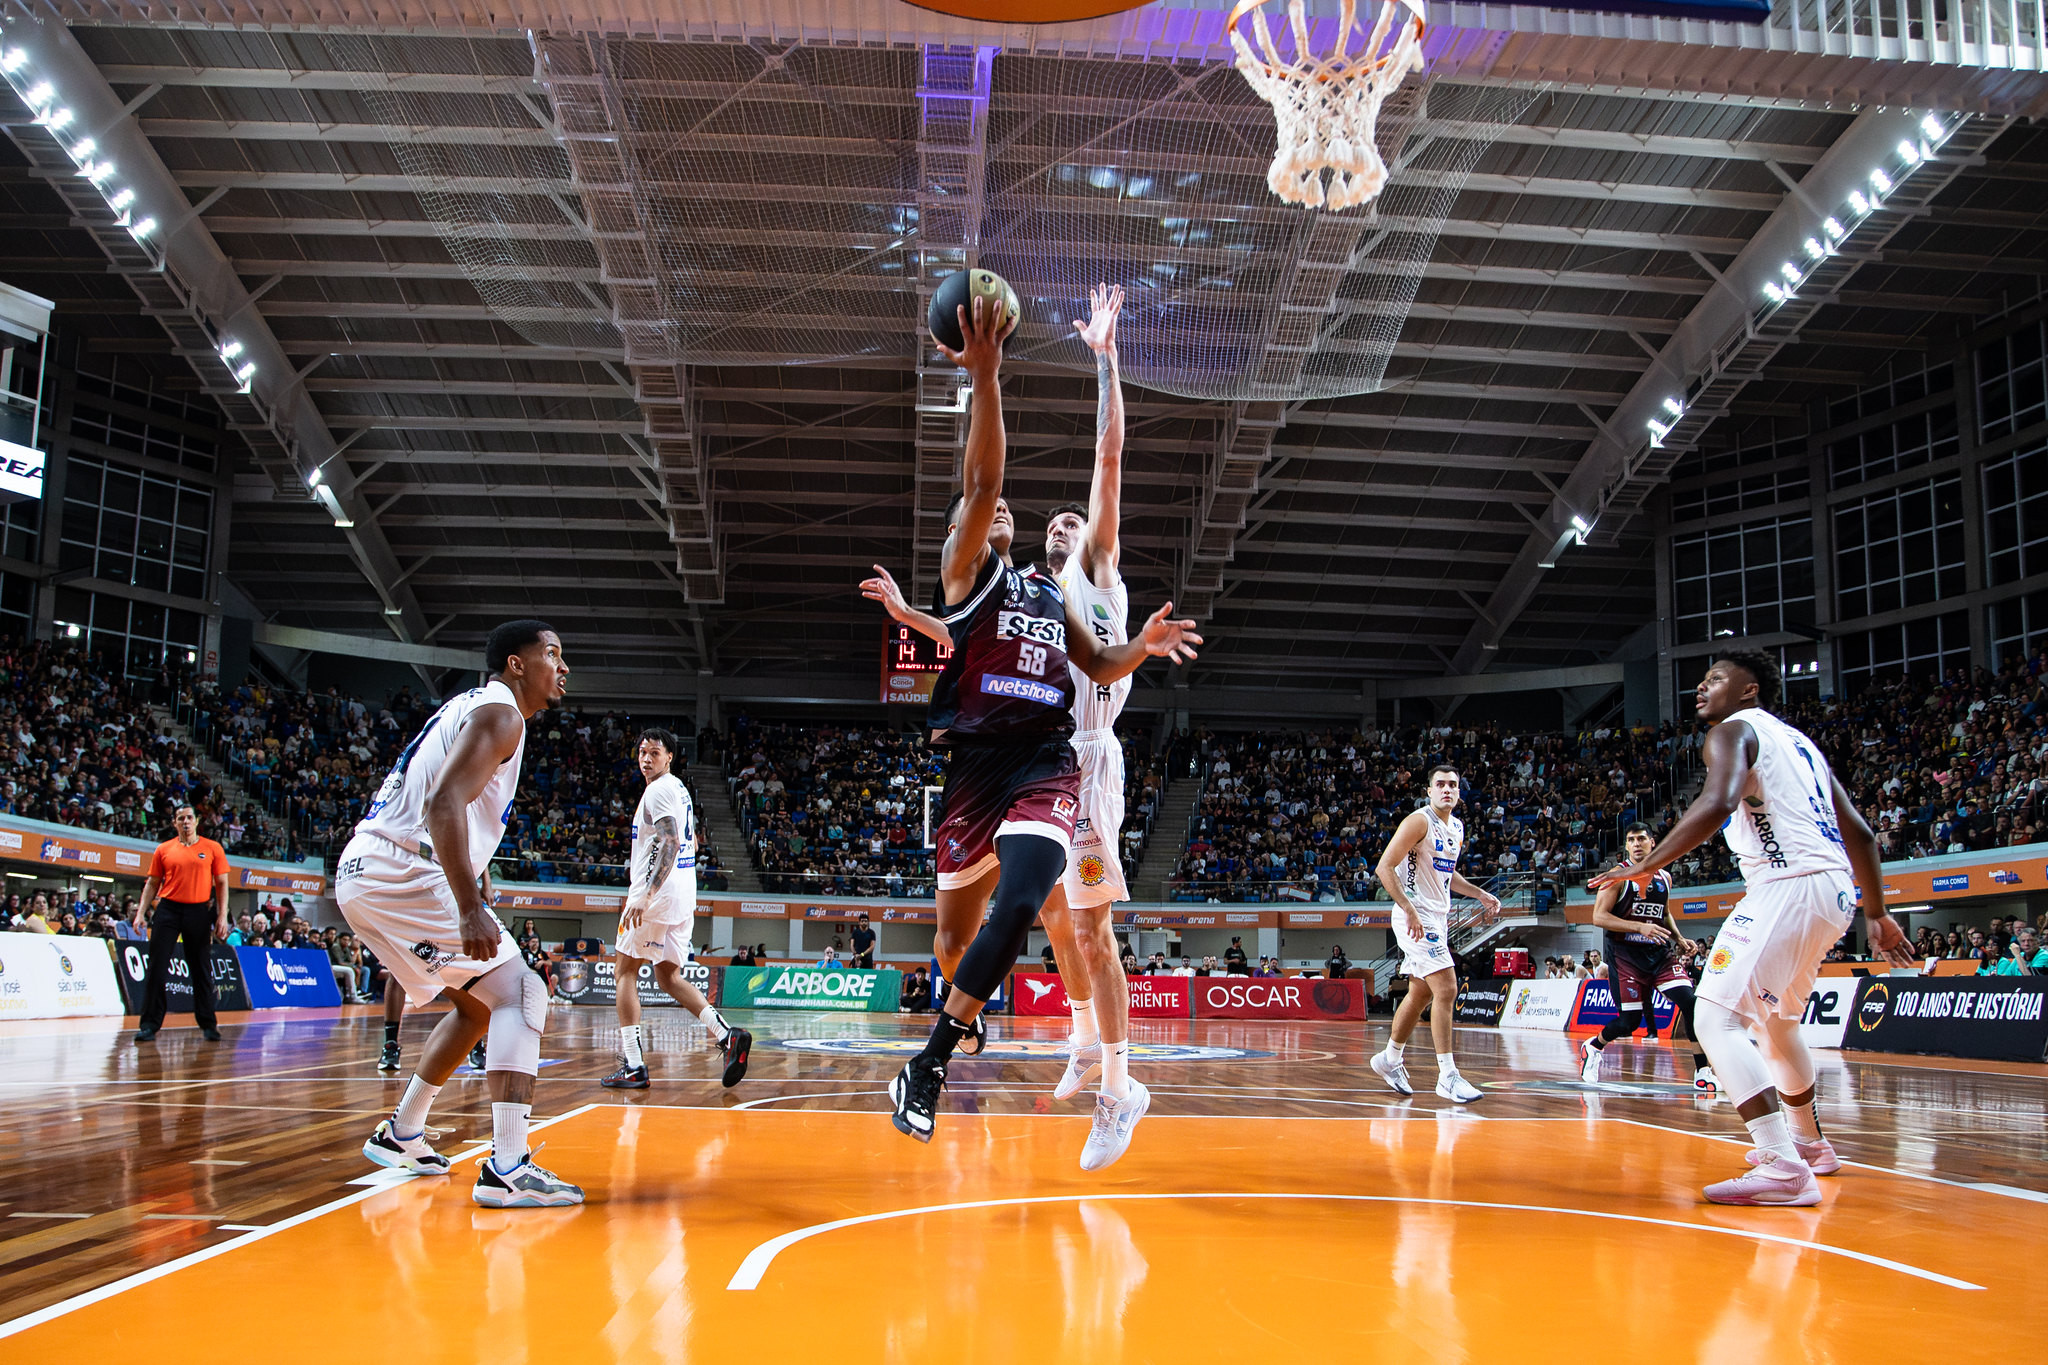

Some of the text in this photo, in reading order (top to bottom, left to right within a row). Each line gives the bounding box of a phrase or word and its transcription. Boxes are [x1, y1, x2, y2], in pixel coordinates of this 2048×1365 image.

[1006, 616, 1063, 645] SESI
[1017, 642, 1047, 676] 58
[889, 691, 929, 702] SAÚDE
[1751, 810, 1788, 868] ÁRBORE
[1405, 849, 1418, 893] ÁRBORE
[1933, 877, 1968, 887] FARMA CONDE
[1634, 904, 1663, 917] SESI
[210, 958, 237, 981] LPE
[594, 962, 652, 979] GRO
[769, 968, 877, 997] ÁRBORE
[1206, 985, 1302, 1009] OSCAR
[1583, 987, 1616, 1008] FARM
[1861, 1002, 1886, 1013] FPB
[1894, 987, 2044, 1020] 100 ANOS DE HISTÓRIA
